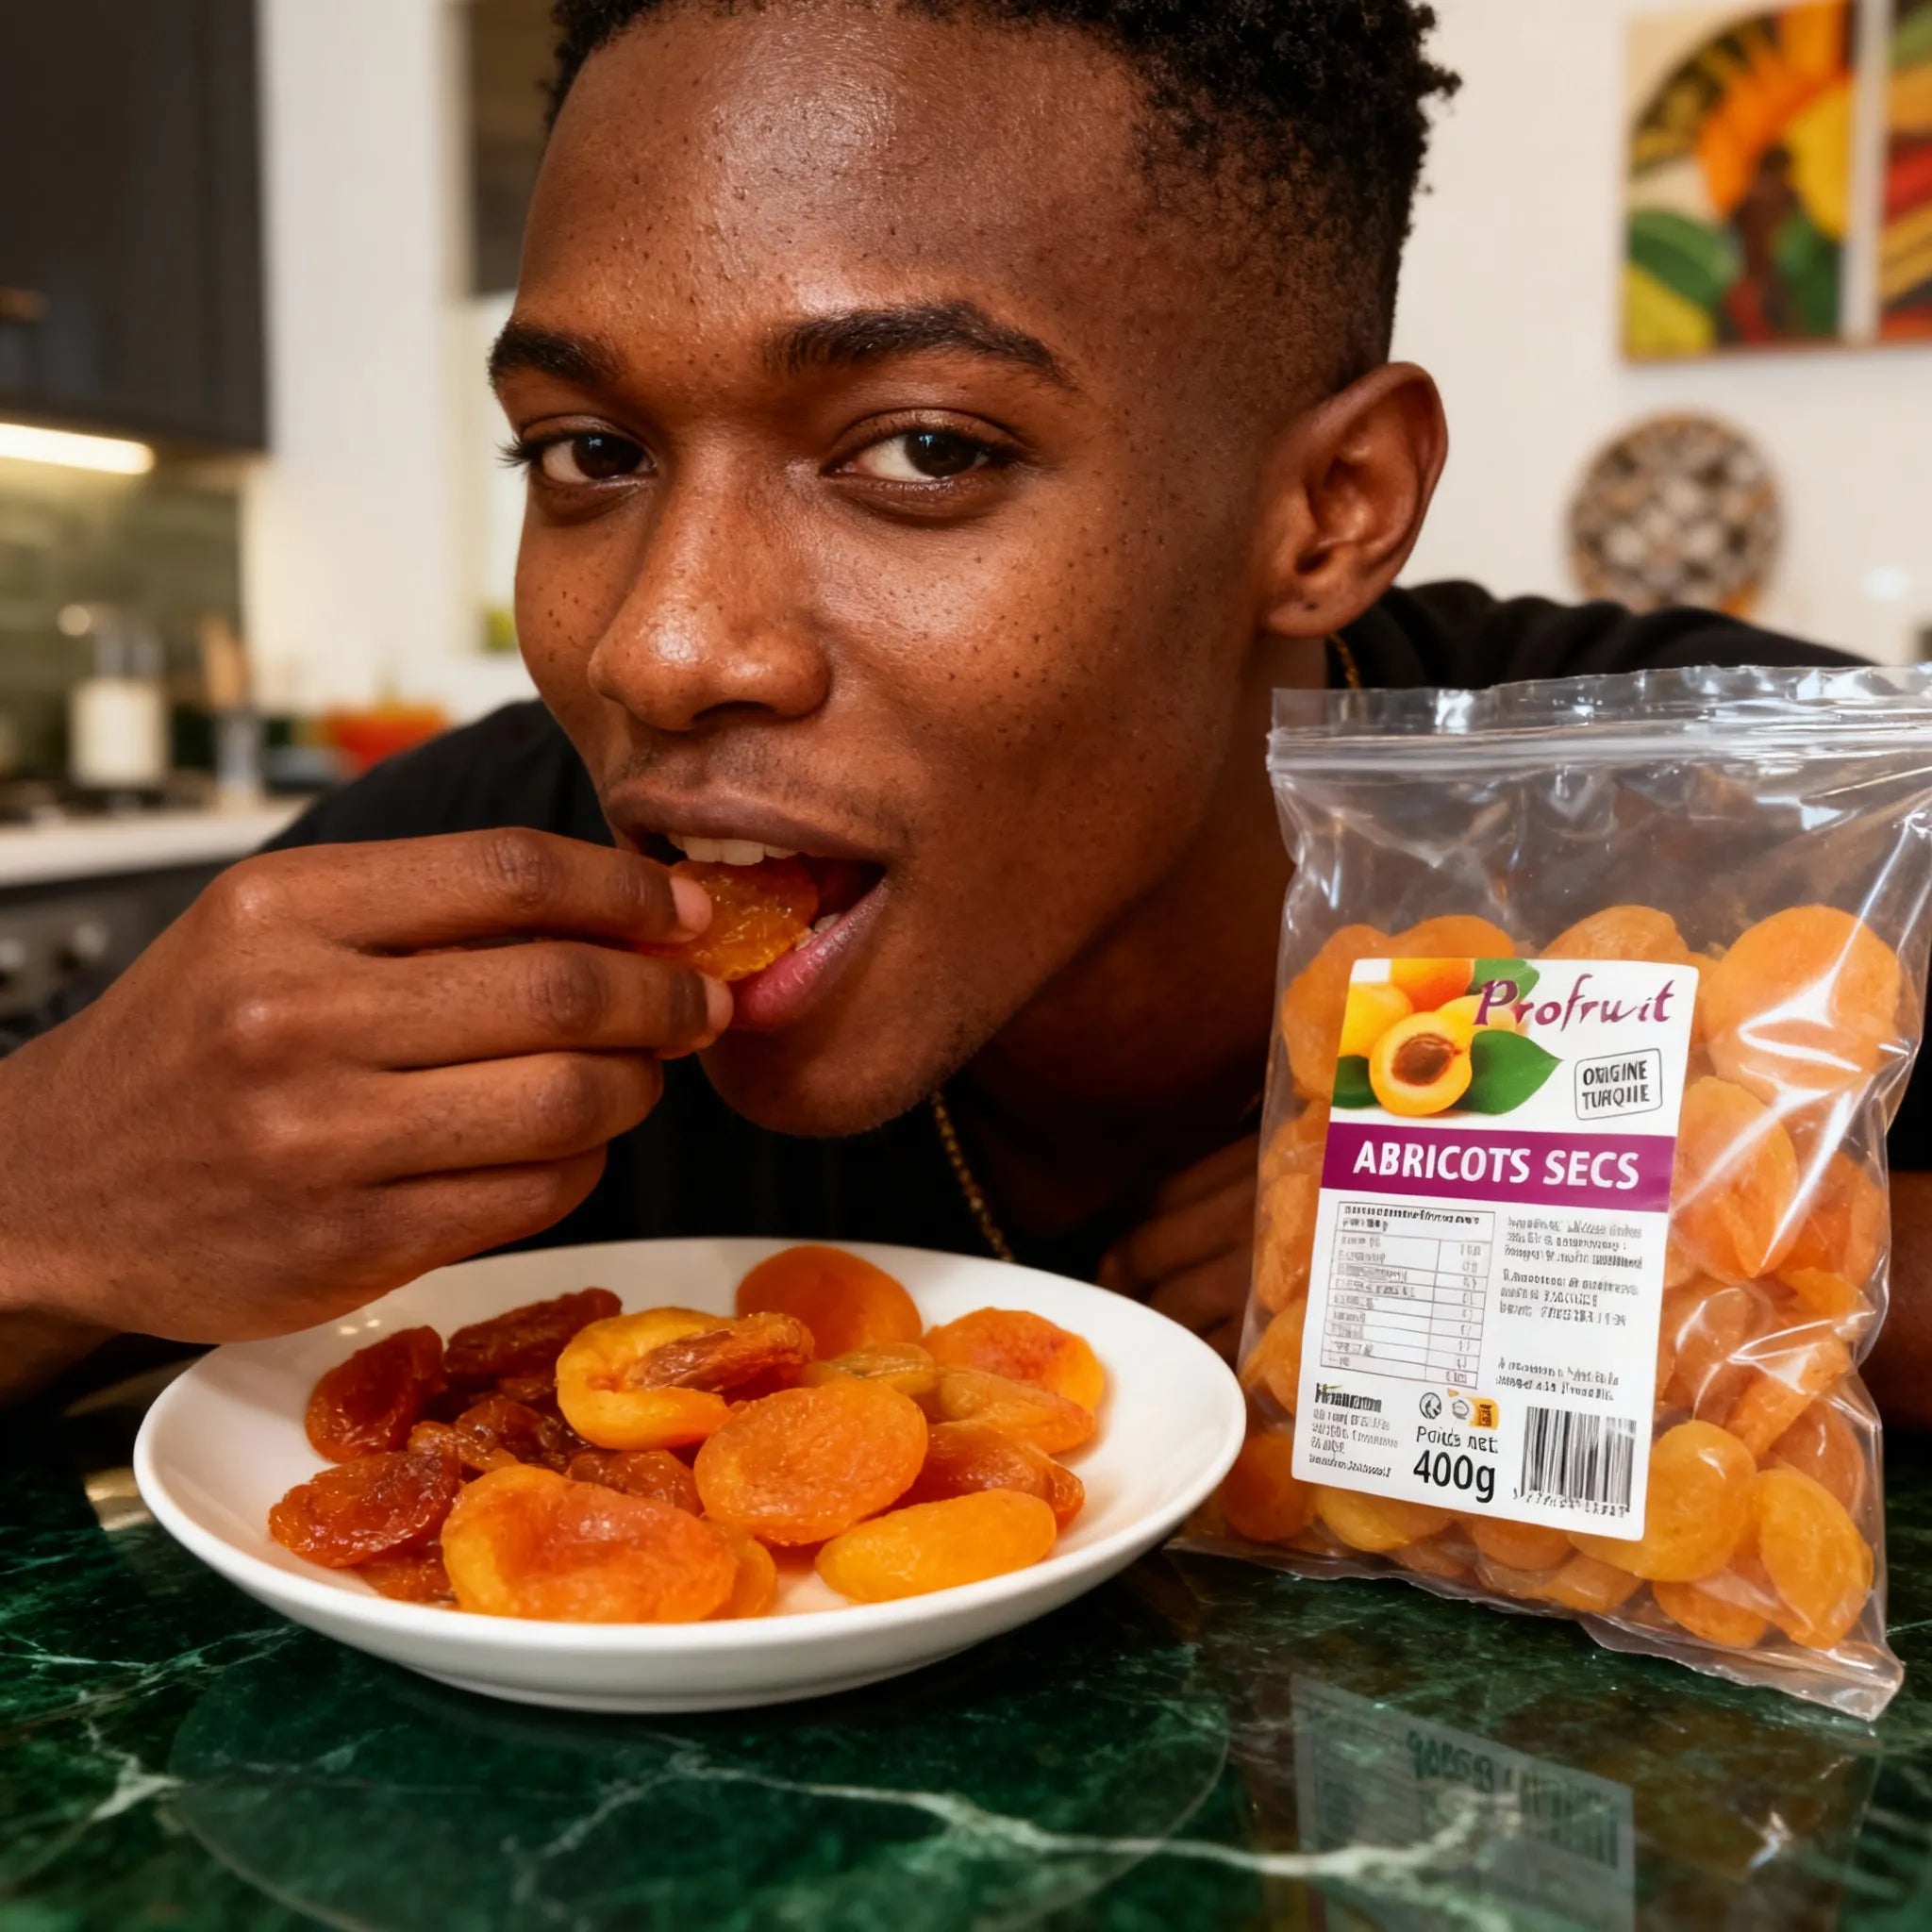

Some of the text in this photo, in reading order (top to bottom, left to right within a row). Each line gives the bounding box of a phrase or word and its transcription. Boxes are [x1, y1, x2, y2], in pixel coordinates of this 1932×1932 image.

[1473, 974, 1674, 1031] Profruit
[1353, 1141, 1640, 1191] ABRICOTS SECS
[1467, 1436, 1498, 1454] net
[1413, 1449, 1495, 1503] 400g
